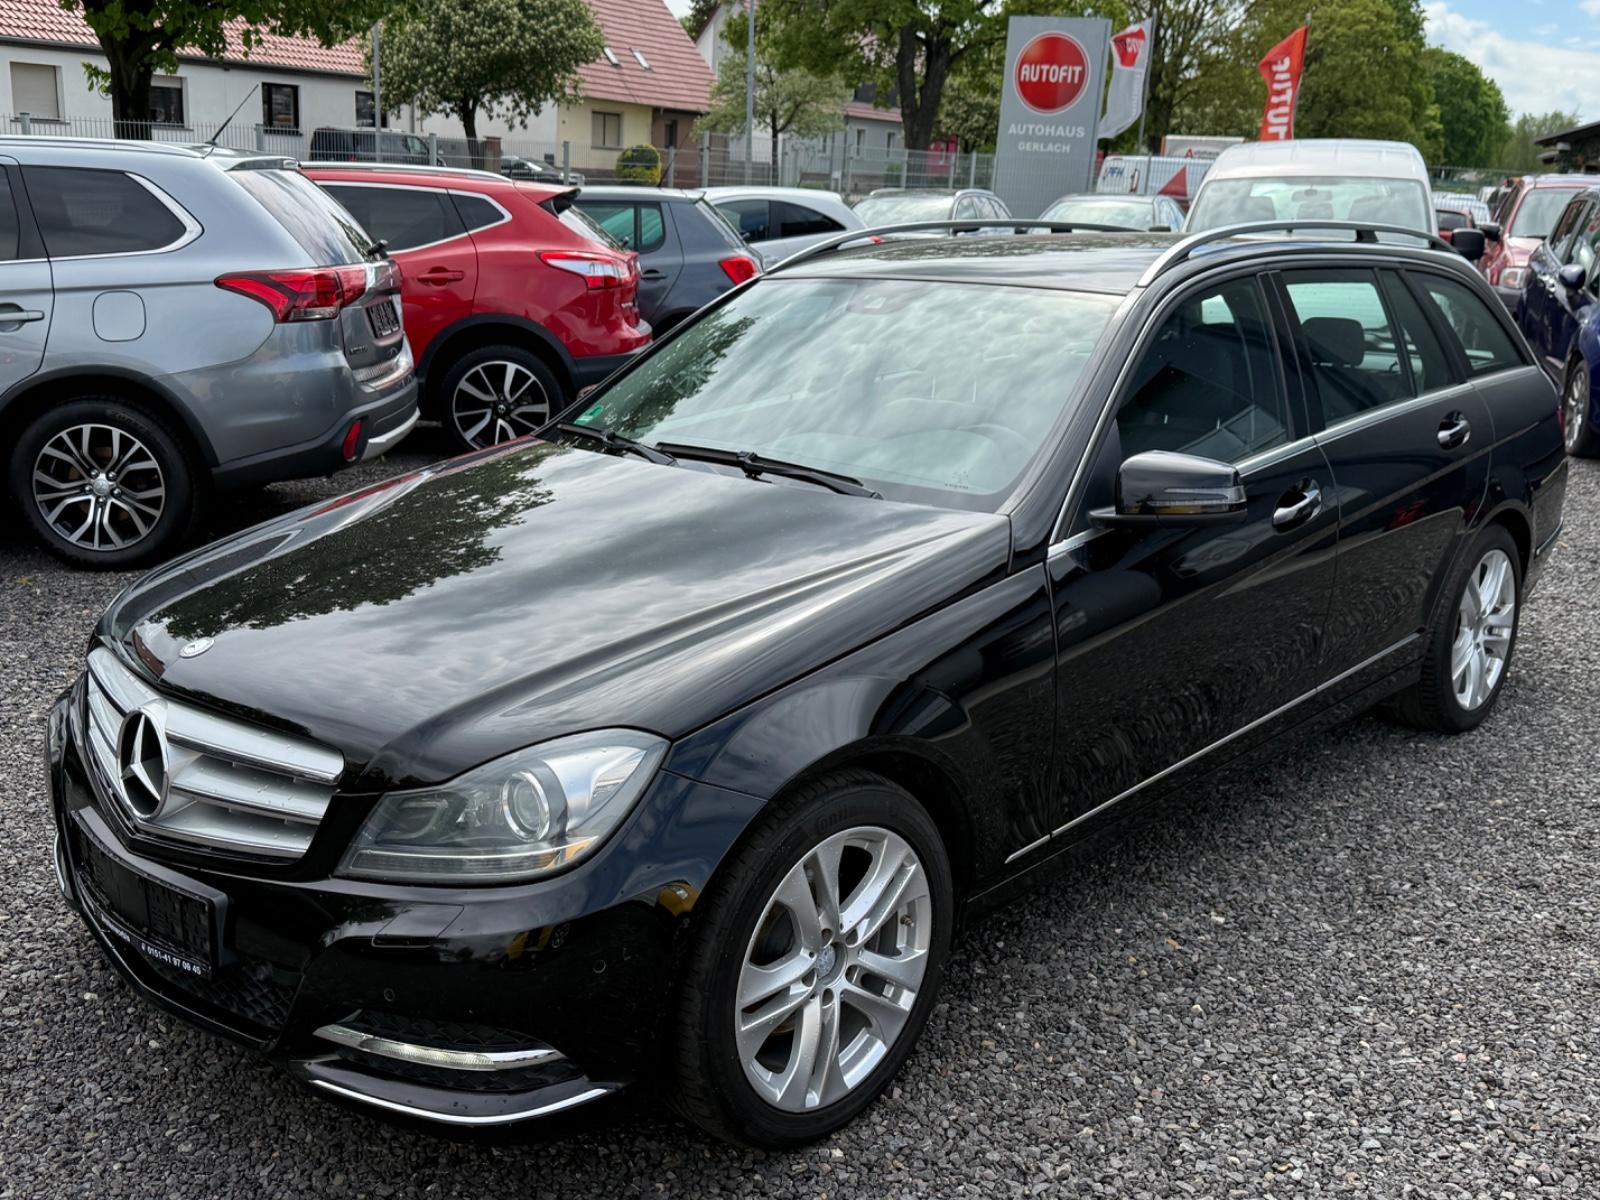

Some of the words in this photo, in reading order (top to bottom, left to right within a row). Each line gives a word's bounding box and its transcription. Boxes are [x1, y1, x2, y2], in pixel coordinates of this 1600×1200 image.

[1020, 64, 1082, 84] AUTOFIT
[1008, 124, 1085, 138] AUTOHAUS
[1018, 142, 1071, 153] GERLACH
